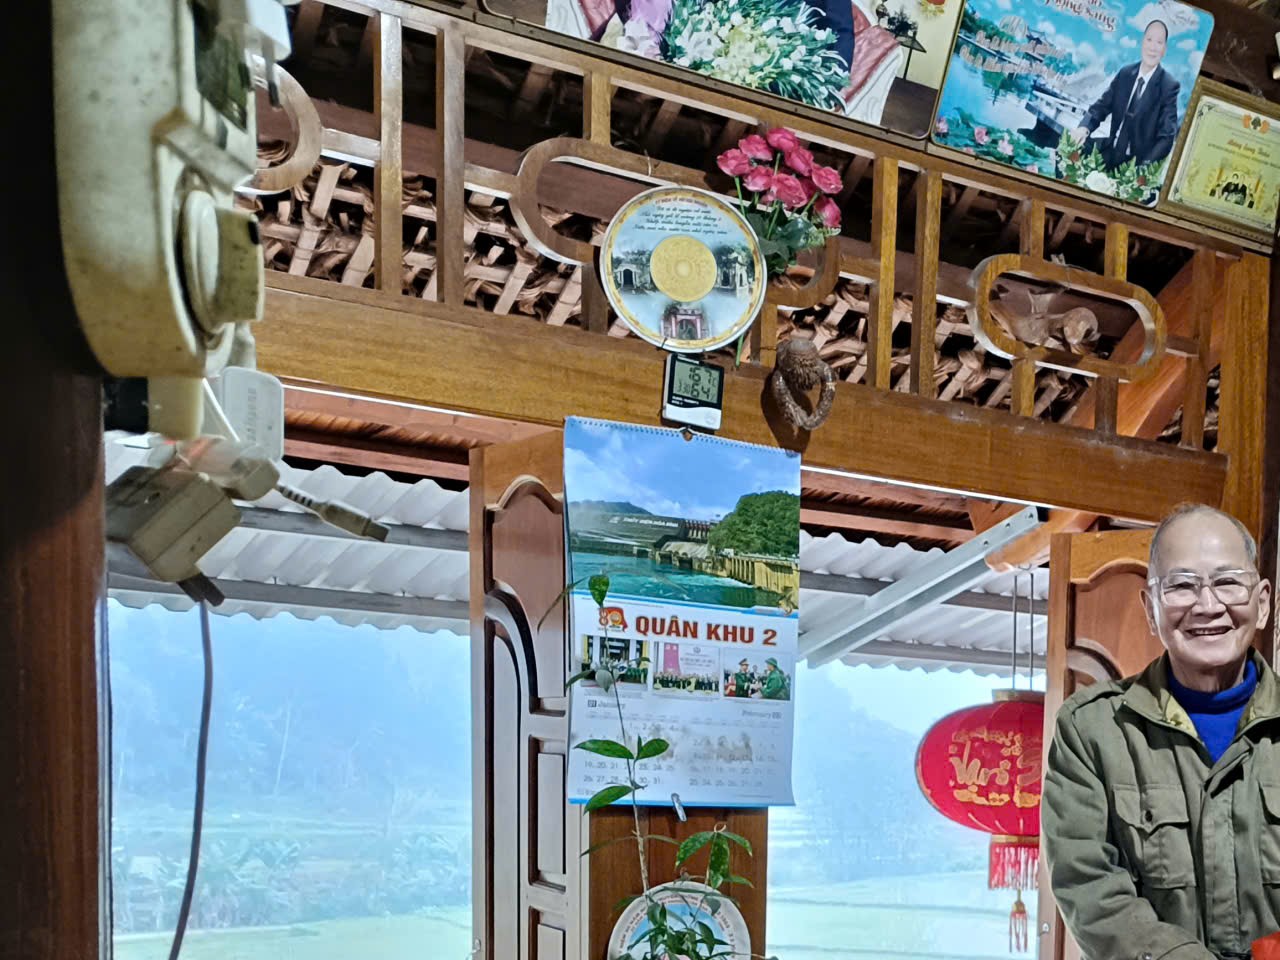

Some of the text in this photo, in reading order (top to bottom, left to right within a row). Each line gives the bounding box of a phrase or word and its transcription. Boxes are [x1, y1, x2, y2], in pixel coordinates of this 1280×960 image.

[635, 614, 777, 646] QUÂN KHU 2
